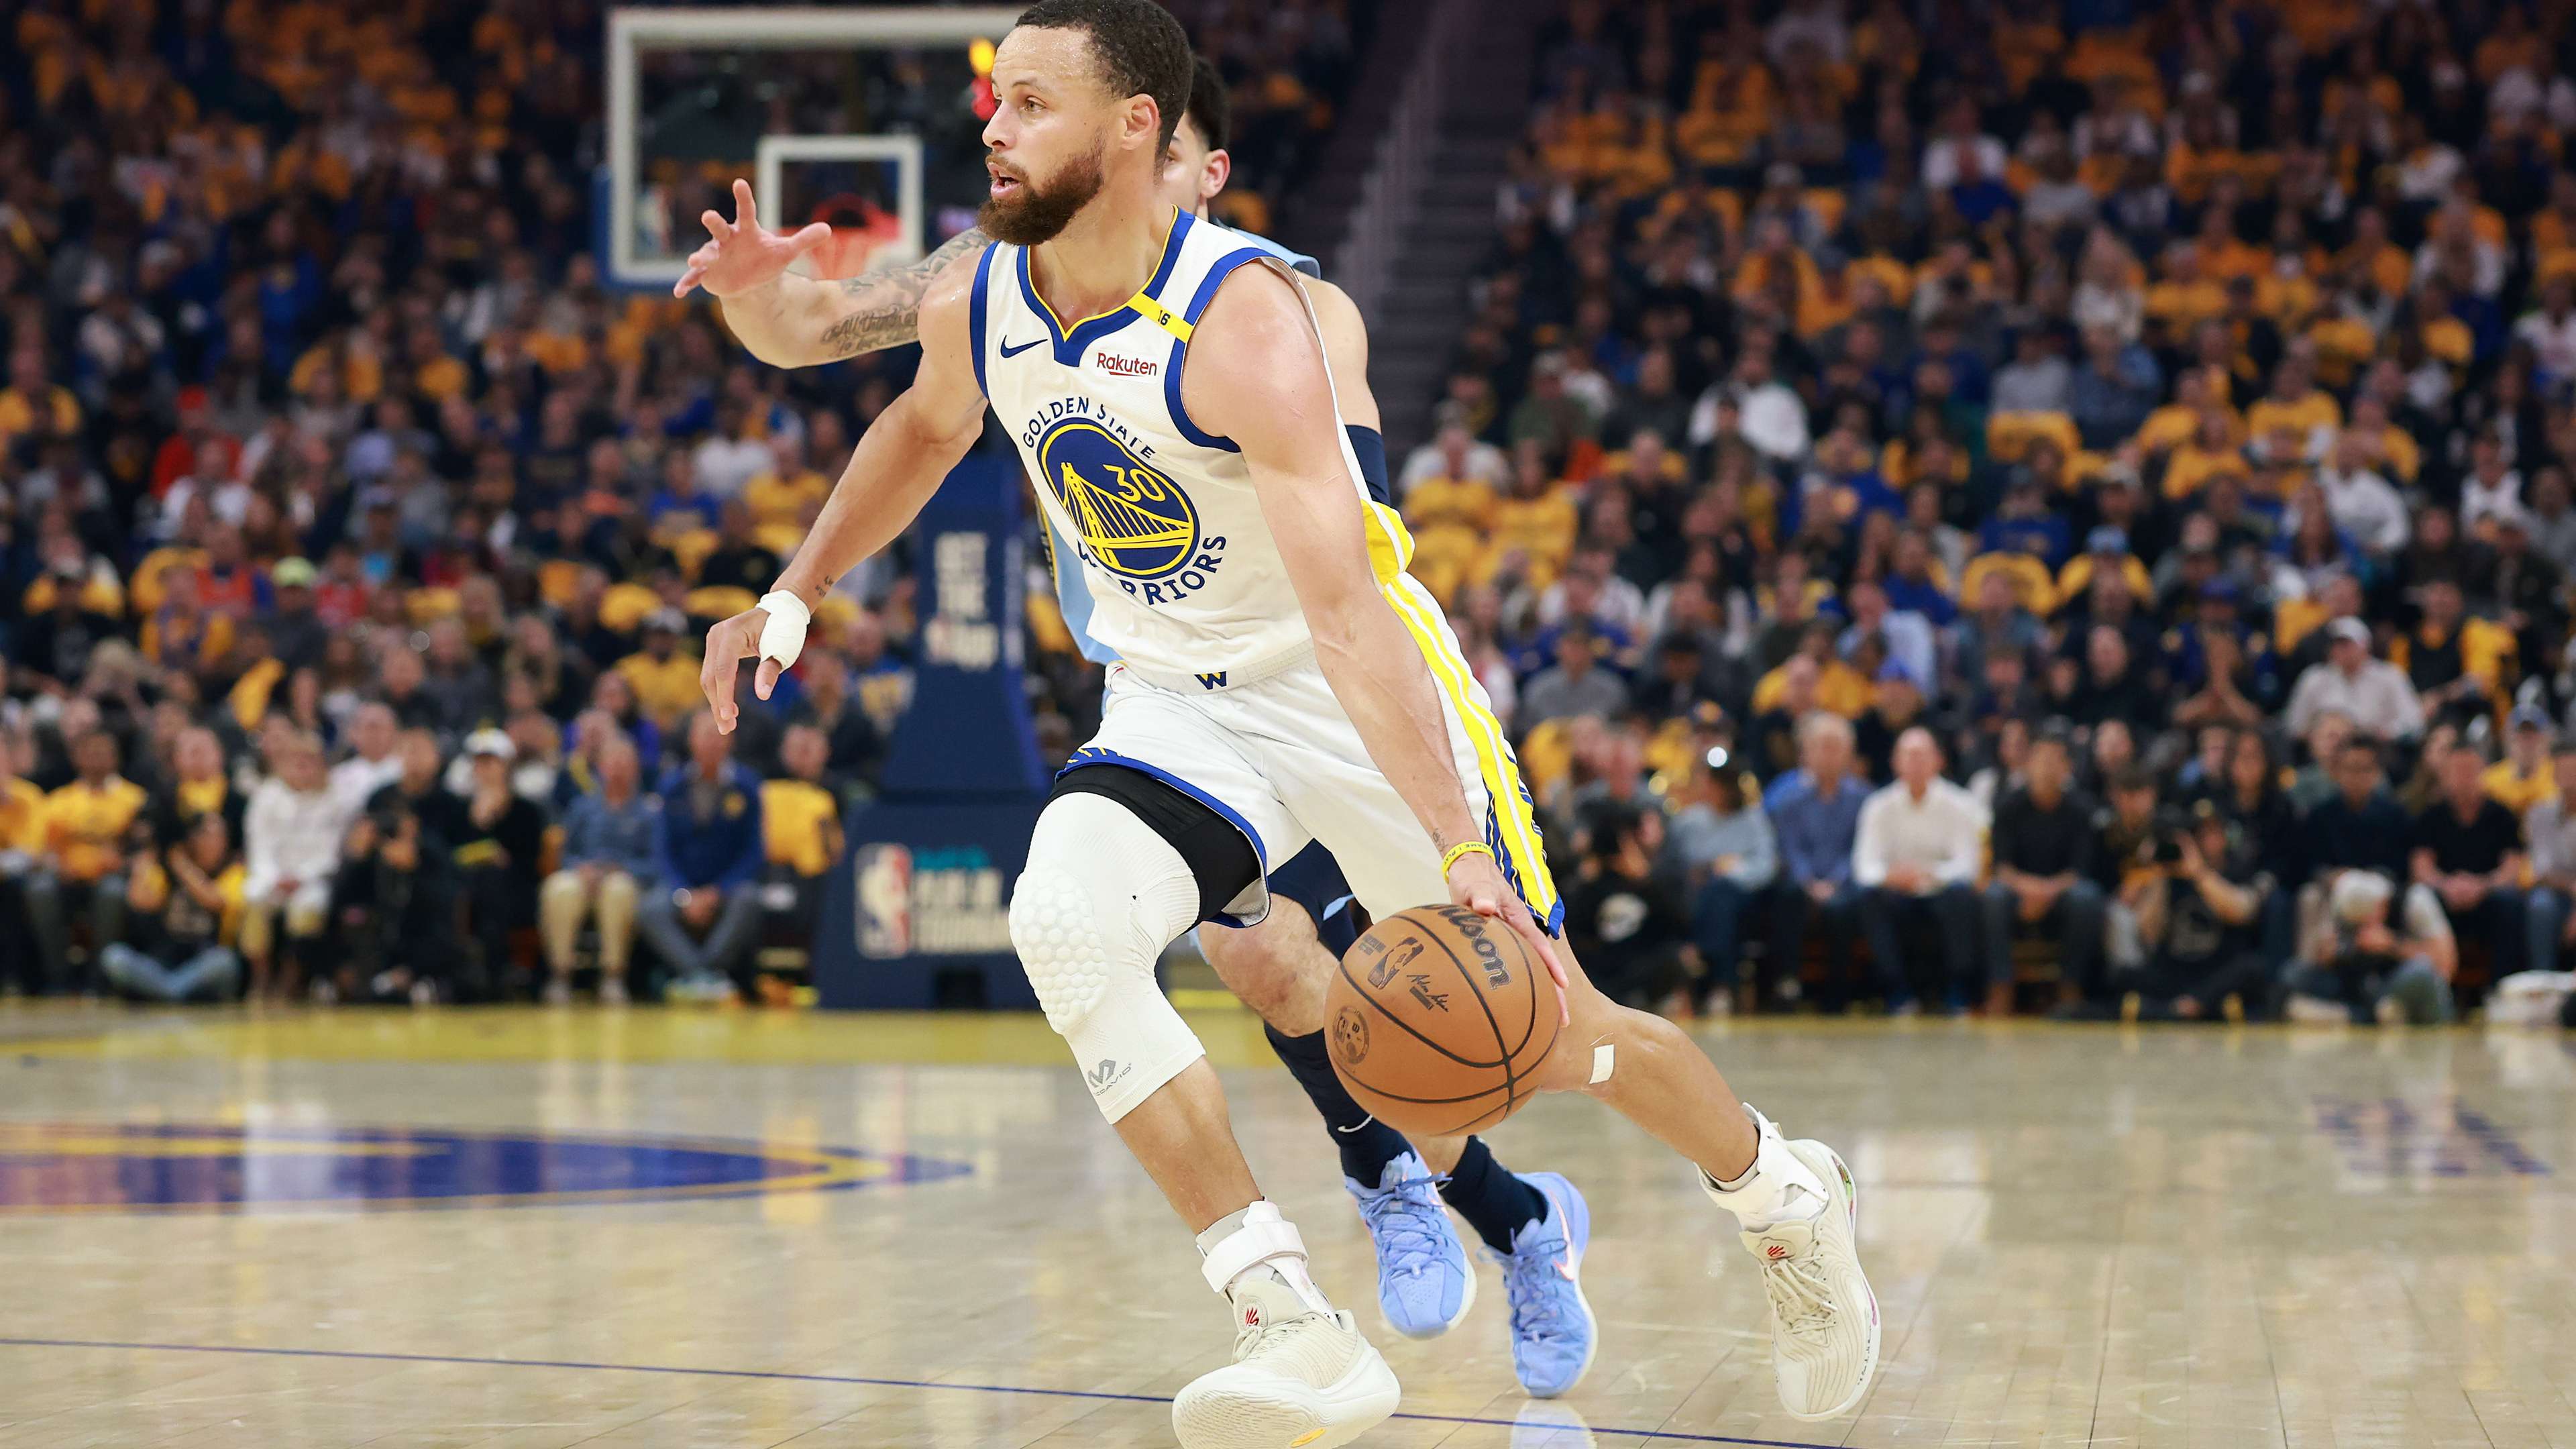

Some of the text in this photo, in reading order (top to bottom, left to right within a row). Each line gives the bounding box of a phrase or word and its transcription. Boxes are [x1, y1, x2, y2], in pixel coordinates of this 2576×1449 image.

[1097, 352, 1157, 376] Rakuten
[1023, 396, 1089, 448] GOLDEN
[1102, 464, 1166, 502] 30
[1077, 536, 1227, 606] WRRIORS
[1194, 671, 1226, 690] W
